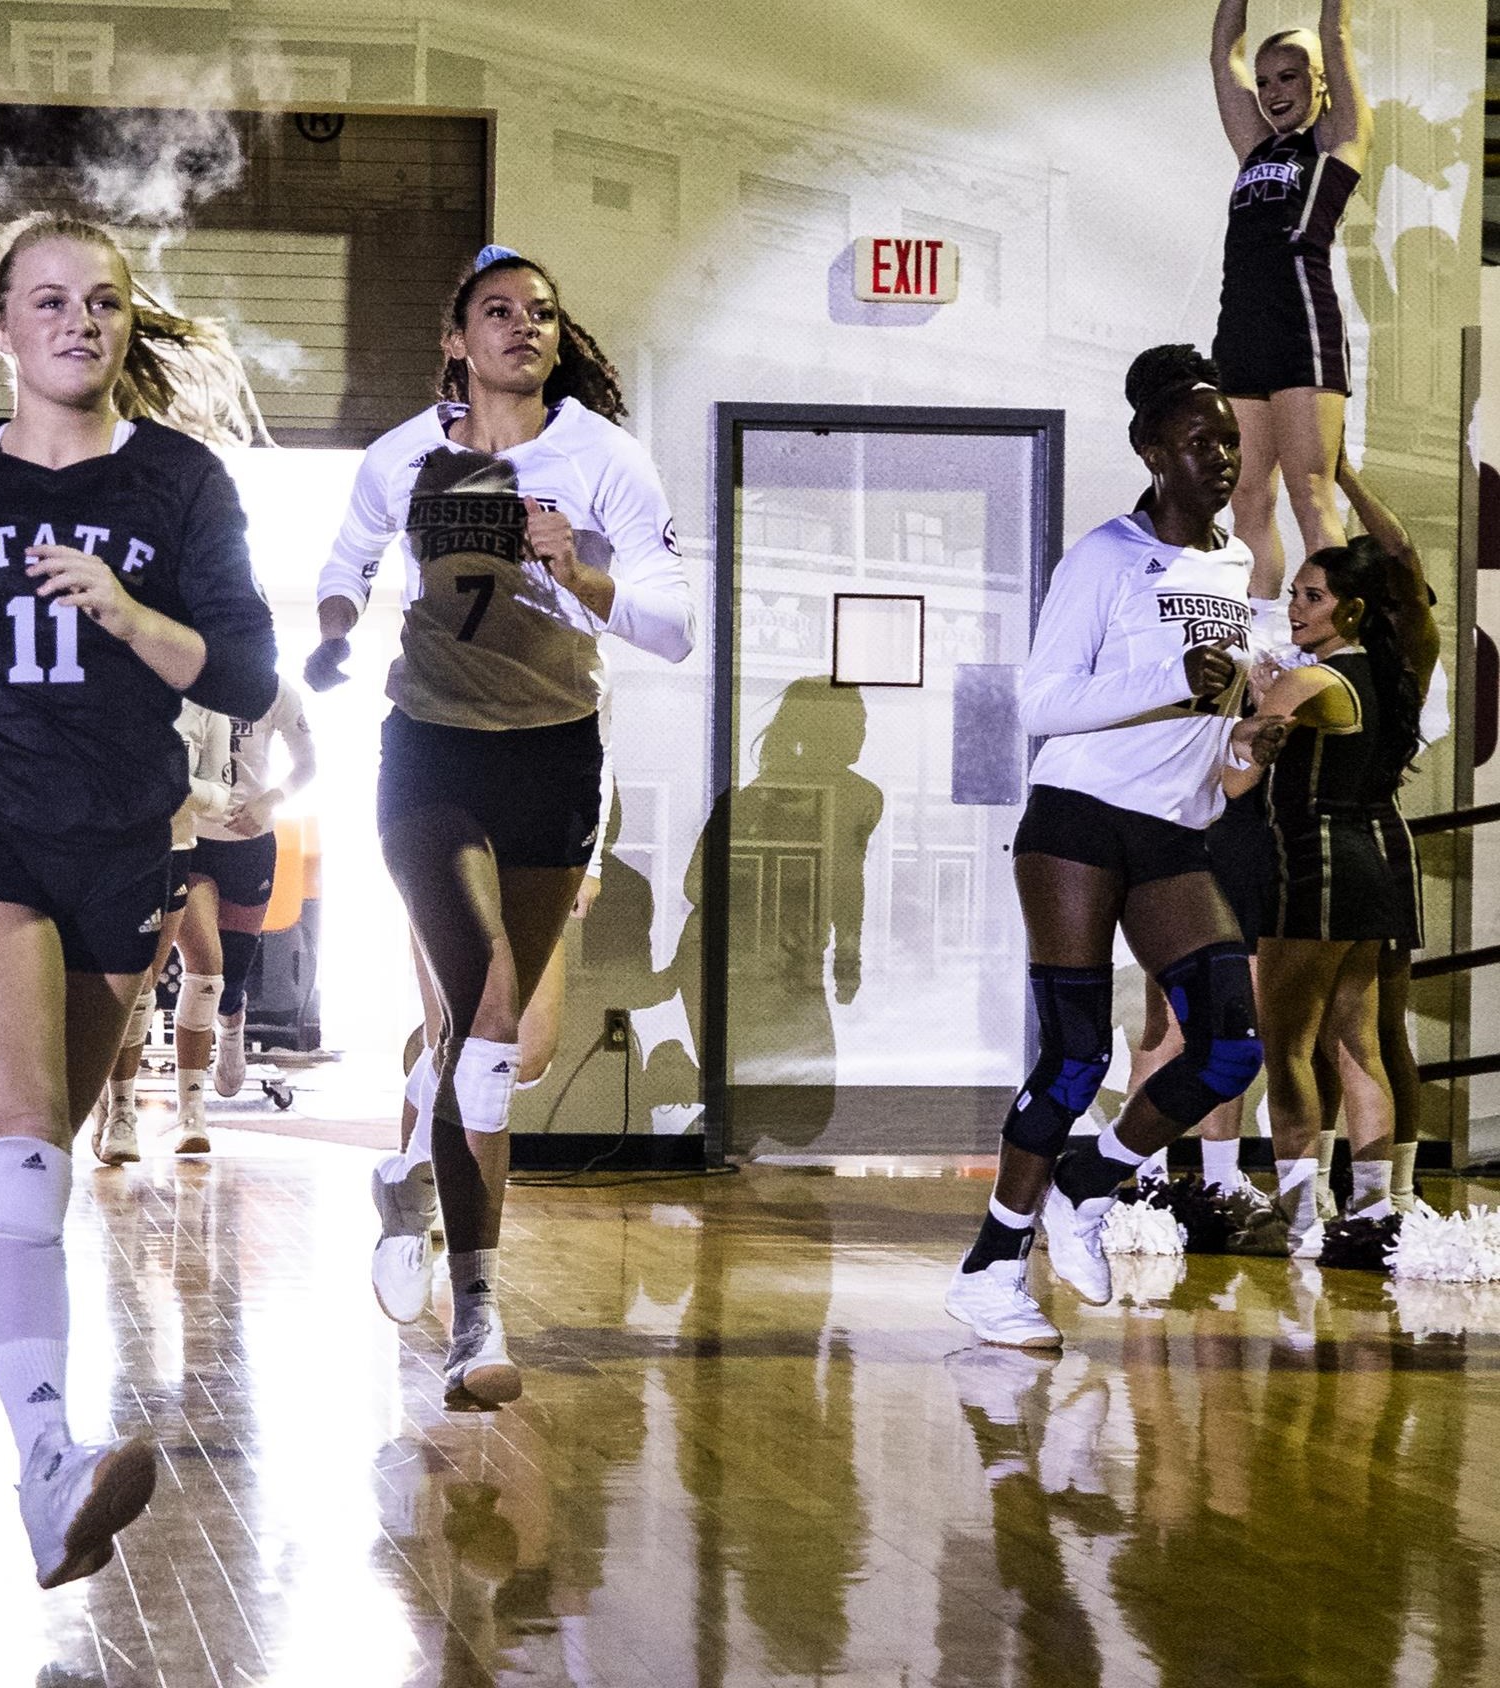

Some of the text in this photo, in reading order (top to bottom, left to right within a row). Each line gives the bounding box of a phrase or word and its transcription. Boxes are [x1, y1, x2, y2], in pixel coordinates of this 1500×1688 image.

[1236, 165, 1285, 187] STATE
[873, 239, 943, 295] EXIT
[407, 500, 556, 526] MISSISSIP
[436, 530, 507, 550] STATE
[455, 574, 495, 641] 7
[1157, 598, 1249, 626] MISSISSIPP
[6, 596, 85, 683] 11
